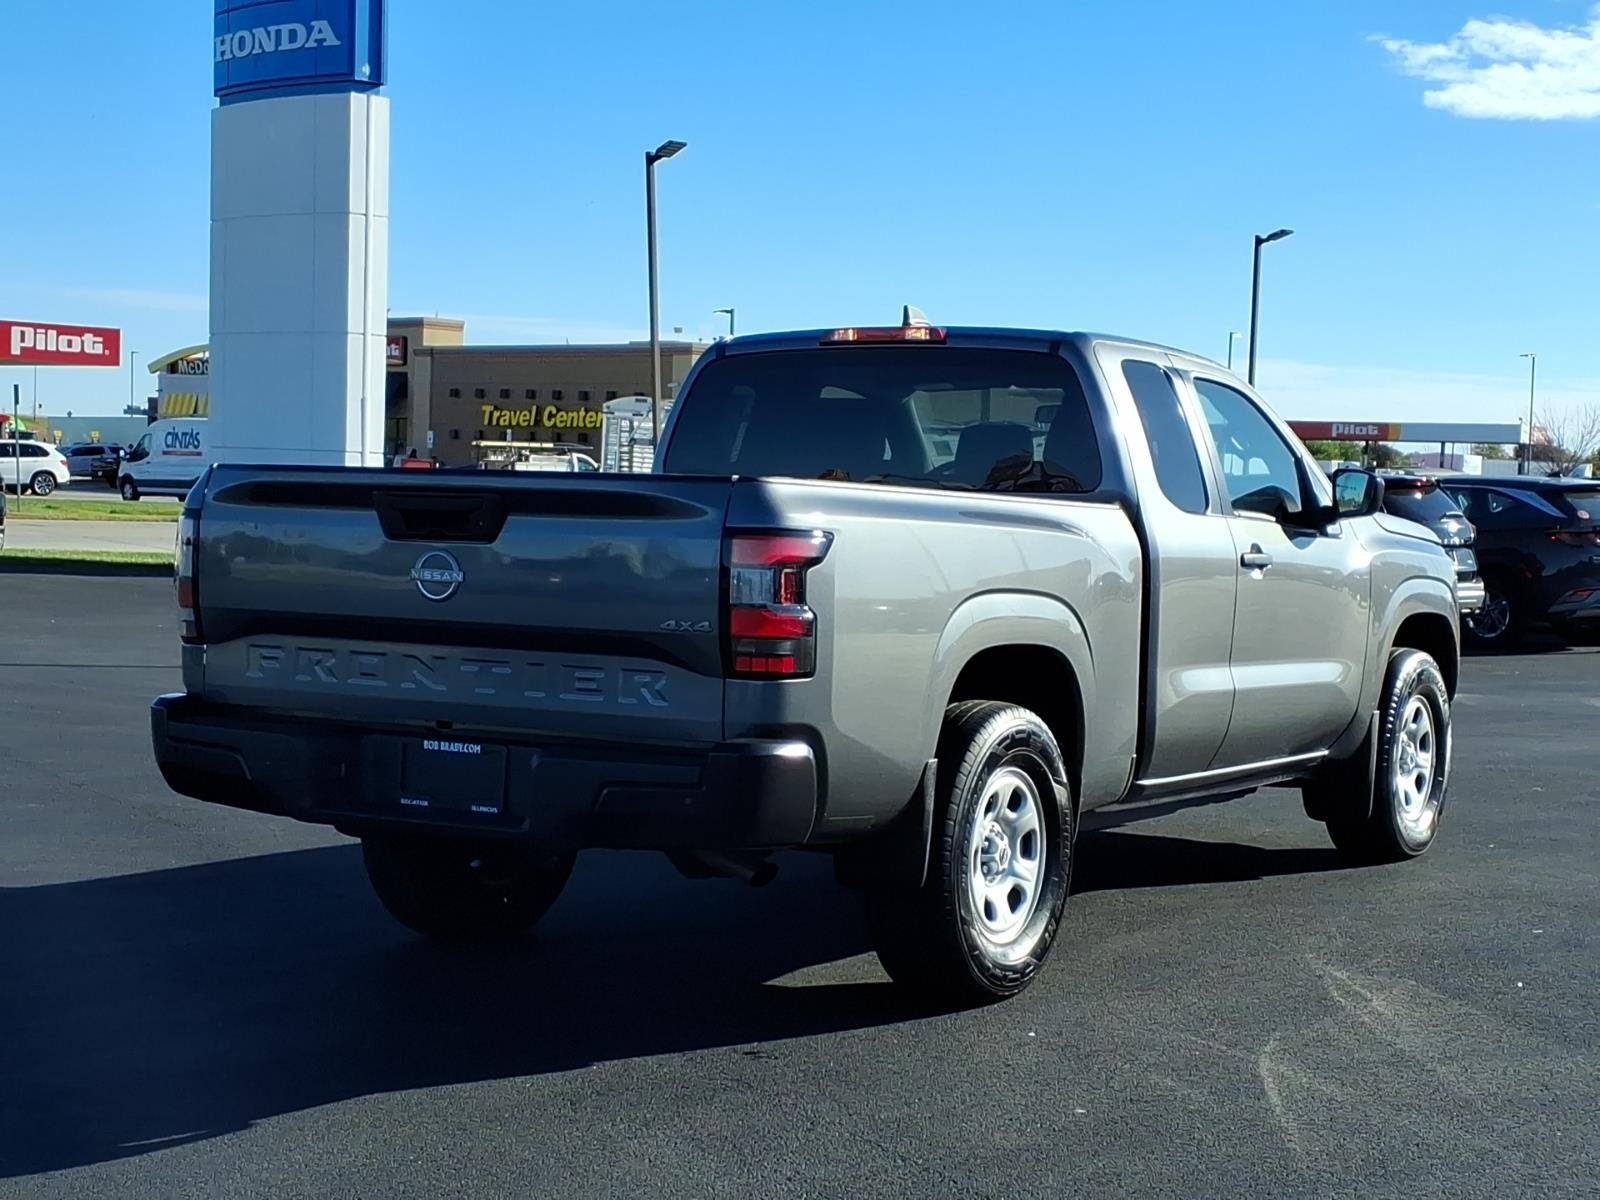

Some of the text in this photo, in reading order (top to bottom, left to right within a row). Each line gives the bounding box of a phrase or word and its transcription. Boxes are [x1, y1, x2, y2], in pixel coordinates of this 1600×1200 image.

[215, 20, 341, 62] HONDA
[482, 404, 537, 426] Travel
[165, 426, 200, 449] CINTAS
[1332, 423, 1378, 437] Pilot
[411, 568, 463, 582] NISSAN
[245, 644, 669, 706] FRONTIER
[423, 740, 439, 750] BOB
